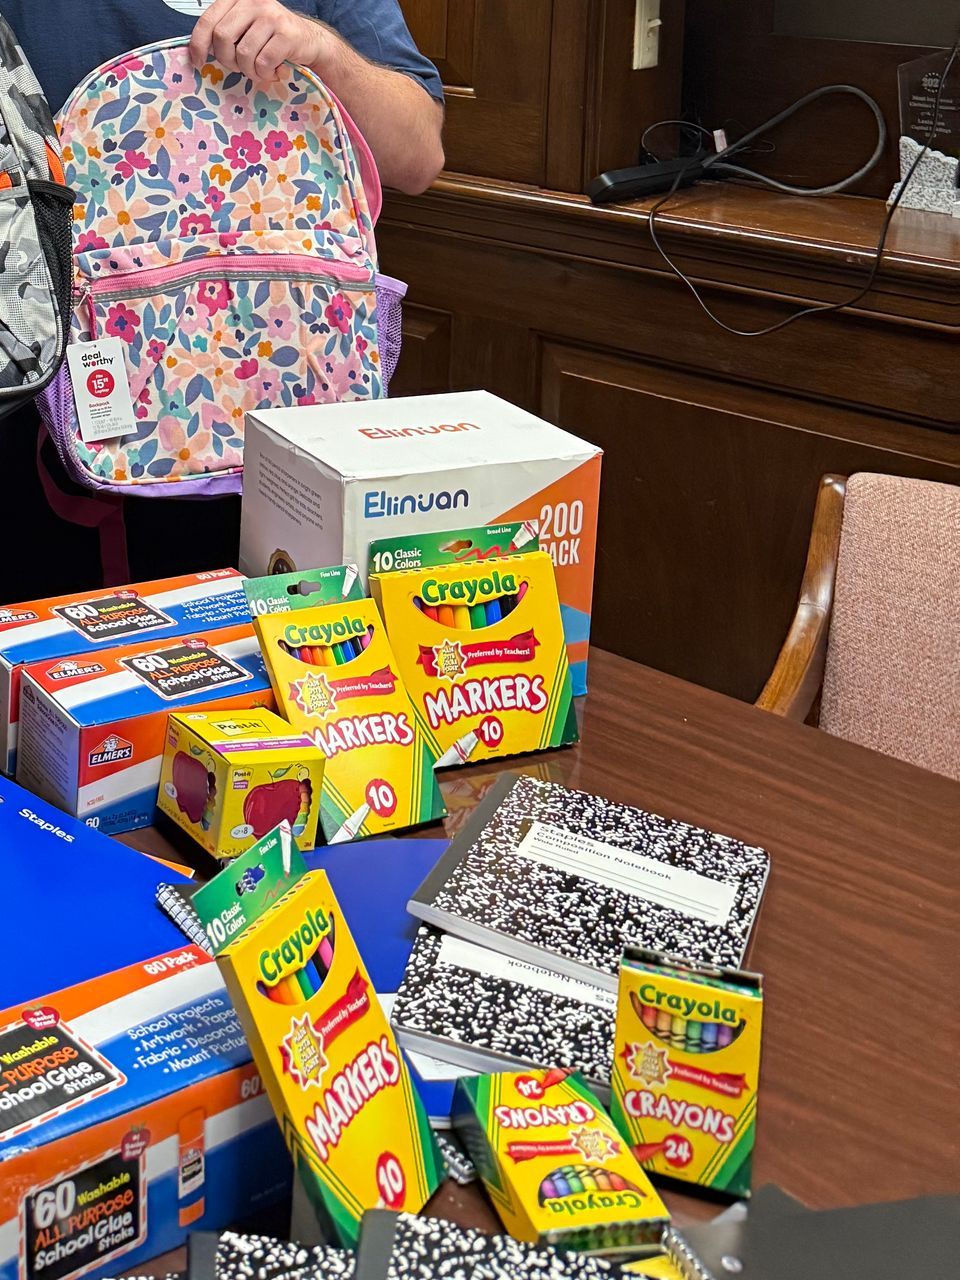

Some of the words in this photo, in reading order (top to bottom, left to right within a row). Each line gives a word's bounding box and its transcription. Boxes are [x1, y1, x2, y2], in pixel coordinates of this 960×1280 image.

[81, 350, 101, 362] deal
[83, 357, 114, 368] worthy
[539, 500, 584, 540] 200
[373, 551, 393, 573] 10
[394, 547, 422, 559] Classic
[394, 559, 422, 569] Colors
[421, 570, 517, 603] Crayola
[64, 604, 99, 620] 60
[250, 598, 268, 617] 10
[266, 596, 289, 606] Classic
[86, 617, 128, 633] School
[284, 615, 366, 645] Crayola
[131, 654, 169, 672] 60
[467, 649, 495, 658] Preferred
[503, 647, 530, 656] Teachers!
[52, 664, 103, 679] ELMER'S
[148, 669, 174, 680] ALL
[157, 669, 200, 687] School
[336, 684, 361, 693] Preferred
[425, 676, 547, 728] MARKERS
[218, 720, 263, 731] Post-it
[306, 714, 414, 757] MARKERS
[481, 721, 501, 742] 10
[90, 748, 132, 765] ELMER'S
[369, 785, 394, 810] 10
[18, 807, 75, 843] Staples
[85, 816, 100, 828] 60
[533, 837, 553, 848] Wide
[554, 844, 579, 855] Ruled
[540, 825, 595, 847] Staples
[536, 832, 611, 860] Composition
[614, 857, 672, 881] Notebook
[221, 901, 242, 924] Classic
[206, 918, 227, 949] 10
[226, 914, 247, 936] Colors
[259, 908, 330, 982] Crayola
[143, 960, 168, 976] 60
[165, 951, 199, 968] Pack
[321, 1010, 344, 1035] Preferred
[341, 1007, 349, 1020] by
[346, 994, 368, 1014] Teachers!
[639, 984, 737, 1022] Crayola
[127, 1016, 172, 1040] School
[168, 998, 224, 1023] Projects
[140, 1022, 197, 1052] Artwork
[0, 1034, 59, 1065] Washable
[136, 1045, 182, 1068] Fabric
[167, 1047, 212, 1072] Mount
[2, 1045, 79, 1086] PURPOSE
[46, 1061, 93, 1086] Glue
[62, 1071, 106, 1095] Sticks
[241, 1075, 260, 1098] 60
[517, 1079, 543, 1096] 24
[306, 1037, 400, 1163] MARKERS
[495, 1101, 595, 1129] CRAYONS
[624, 1091, 735, 1142] CRAYONS
[665, 1140, 690, 1162] 24
[379, 1158, 403, 1202] 10
[34, 1180, 76, 1229] 60
[76, 1172, 131, 1206] Washable
[547, 1192, 641, 1216] Crayola
[34, 1224, 66, 1252] ALL
[67, 1188, 134, 1234] PURPOSE
[33, 1224, 94, 1271] School
[94, 1210, 133, 1240] Glue
